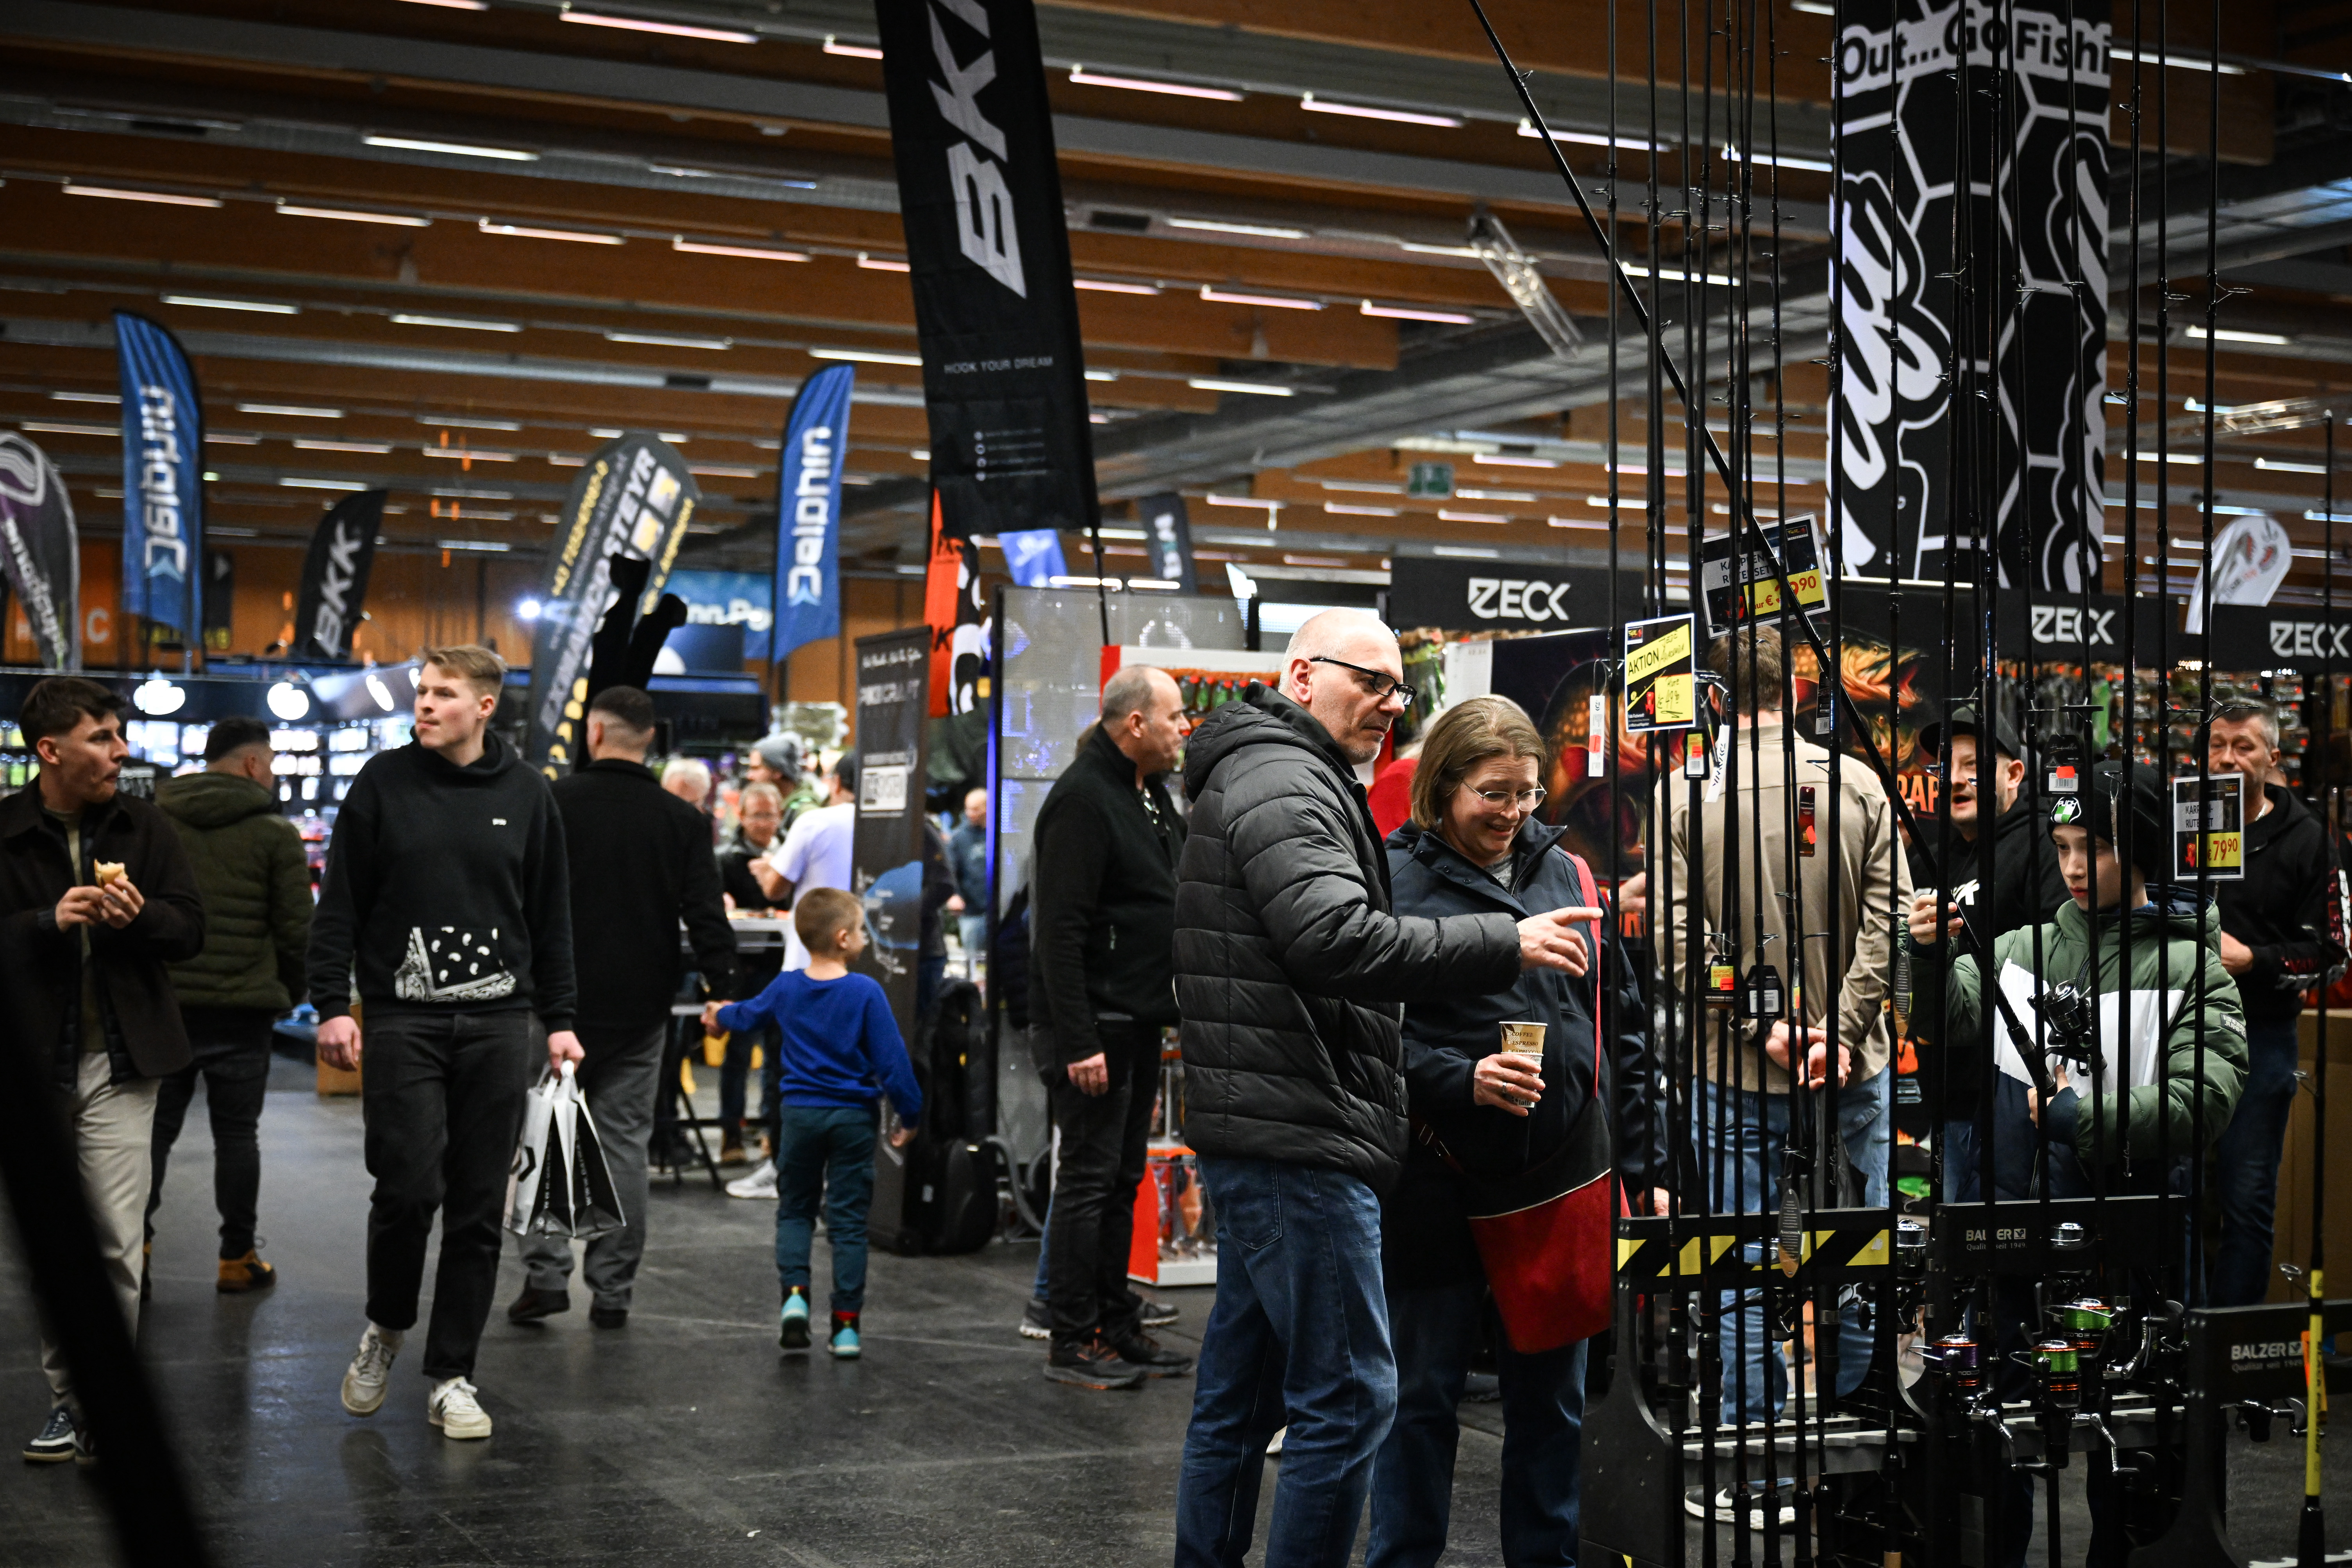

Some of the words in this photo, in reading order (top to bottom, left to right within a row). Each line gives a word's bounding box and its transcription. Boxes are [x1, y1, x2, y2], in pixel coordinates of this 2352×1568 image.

[927, 0, 1027, 299] BK
[944, 362, 978, 374] HOOK
[980, 359, 1011, 371] YOUR
[604, 446, 657, 559] STEYR
[314, 520, 363, 659] BKK
[1468, 577, 1571, 621] ZECK
[2032, 605, 2116, 645] ZECK
[2270, 620, 2352, 660] ZECK
[1628, 648, 1660, 676] AKTION
[1966, 1229, 2012, 1241] BALER
[2231, 1343, 2286, 1361] BALZER
